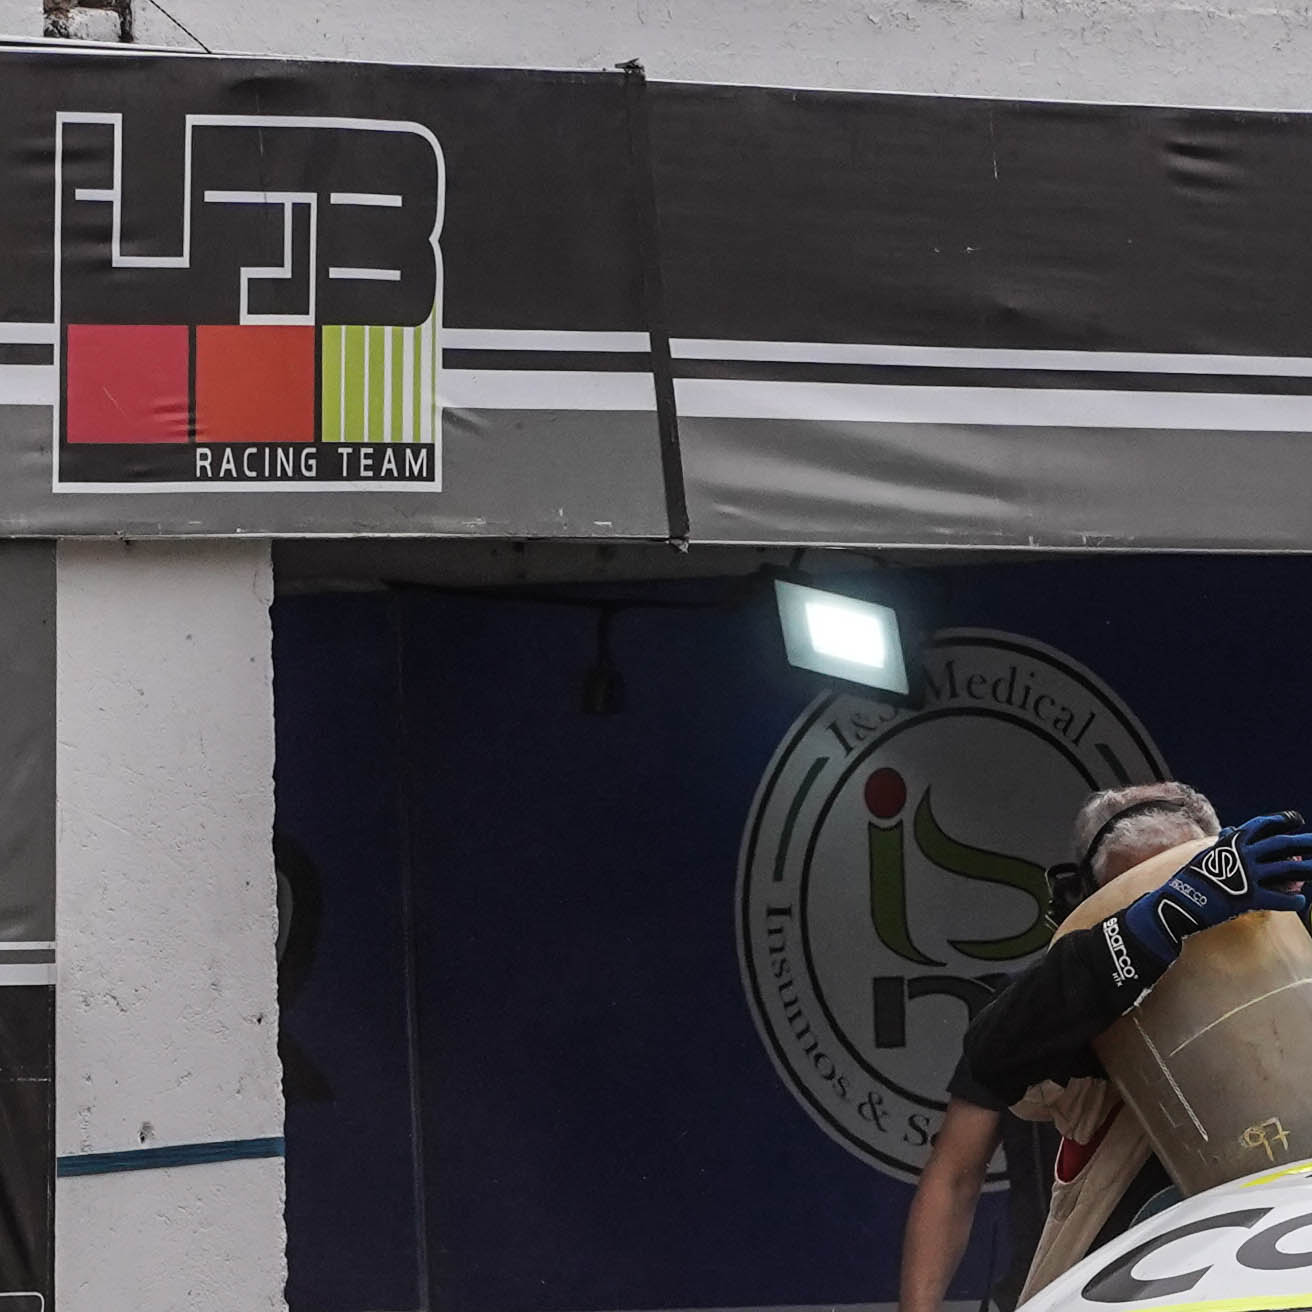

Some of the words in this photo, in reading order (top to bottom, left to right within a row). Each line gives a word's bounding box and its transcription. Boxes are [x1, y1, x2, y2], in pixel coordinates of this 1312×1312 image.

[194, 446, 318, 479] RACING
[340, 446, 428, 478] TEAM
[1102, 916, 1136, 979] sparco
[766, 904, 851, 1098] Insumos
[1239, 1116, 1291, 1162] 97
